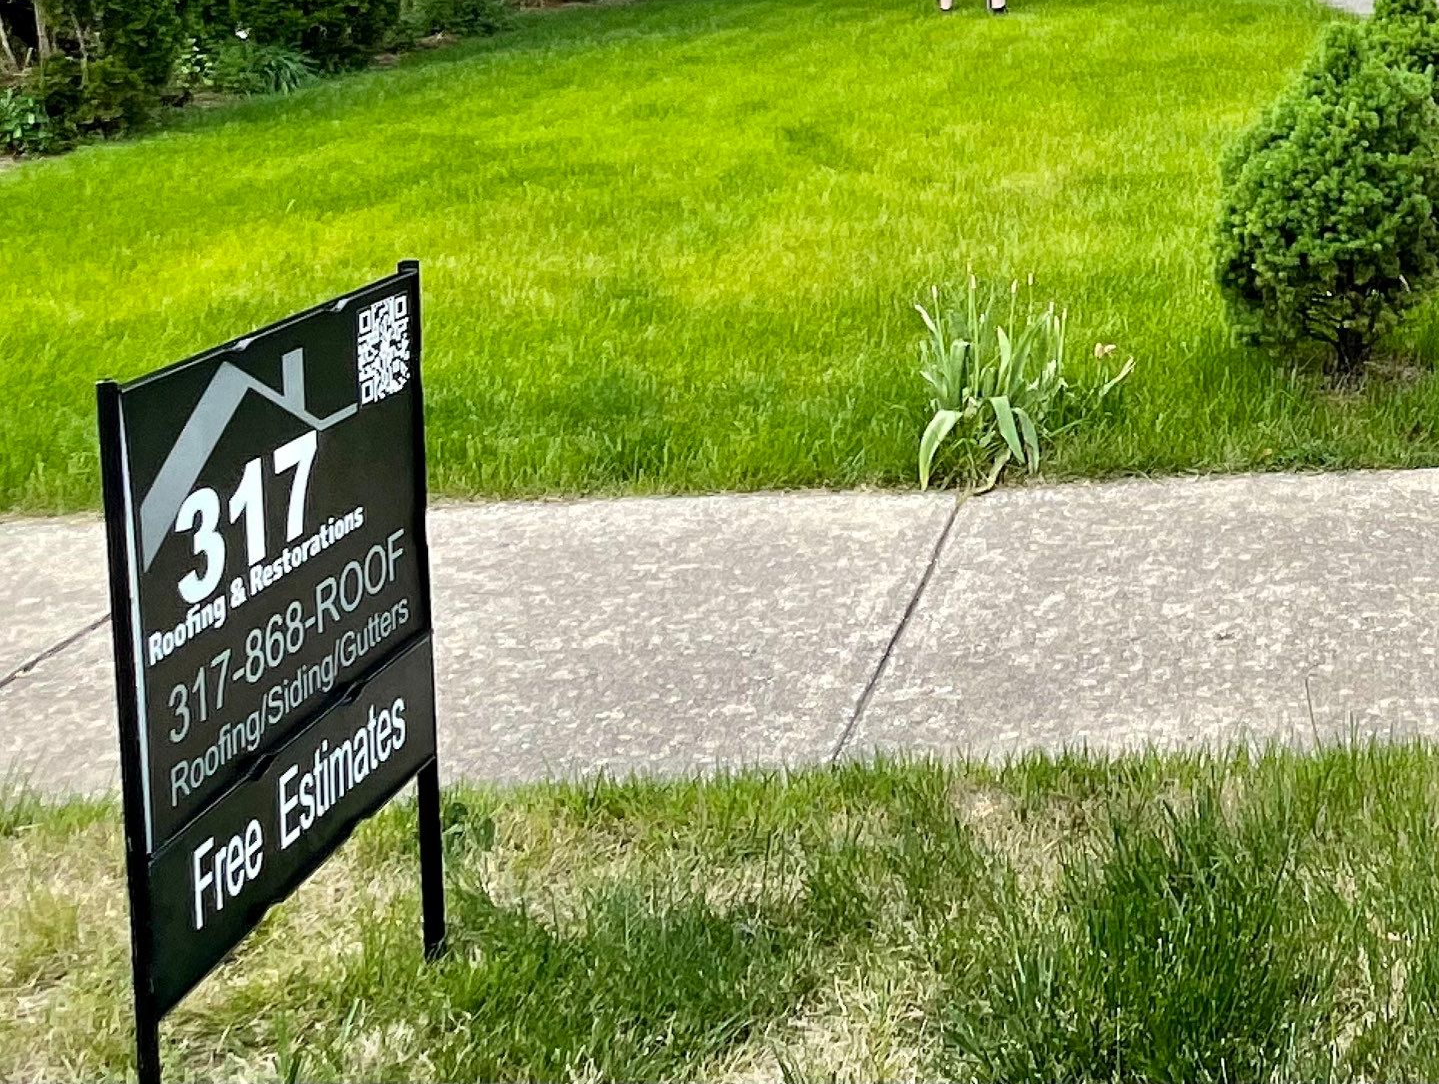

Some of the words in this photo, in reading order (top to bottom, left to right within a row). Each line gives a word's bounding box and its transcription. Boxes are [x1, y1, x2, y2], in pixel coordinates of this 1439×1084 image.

[148, 594, 226, 666] Roofing
[229, 578, 247, 608] &
[249, 507, 364, 596] Restorations
[175, 430, 317, 604] 317
[169, 529, 405, 744] 317-868-ROOF
[192, 819, 263, 930] Free
[277, 698, 406, 849] Estimates
